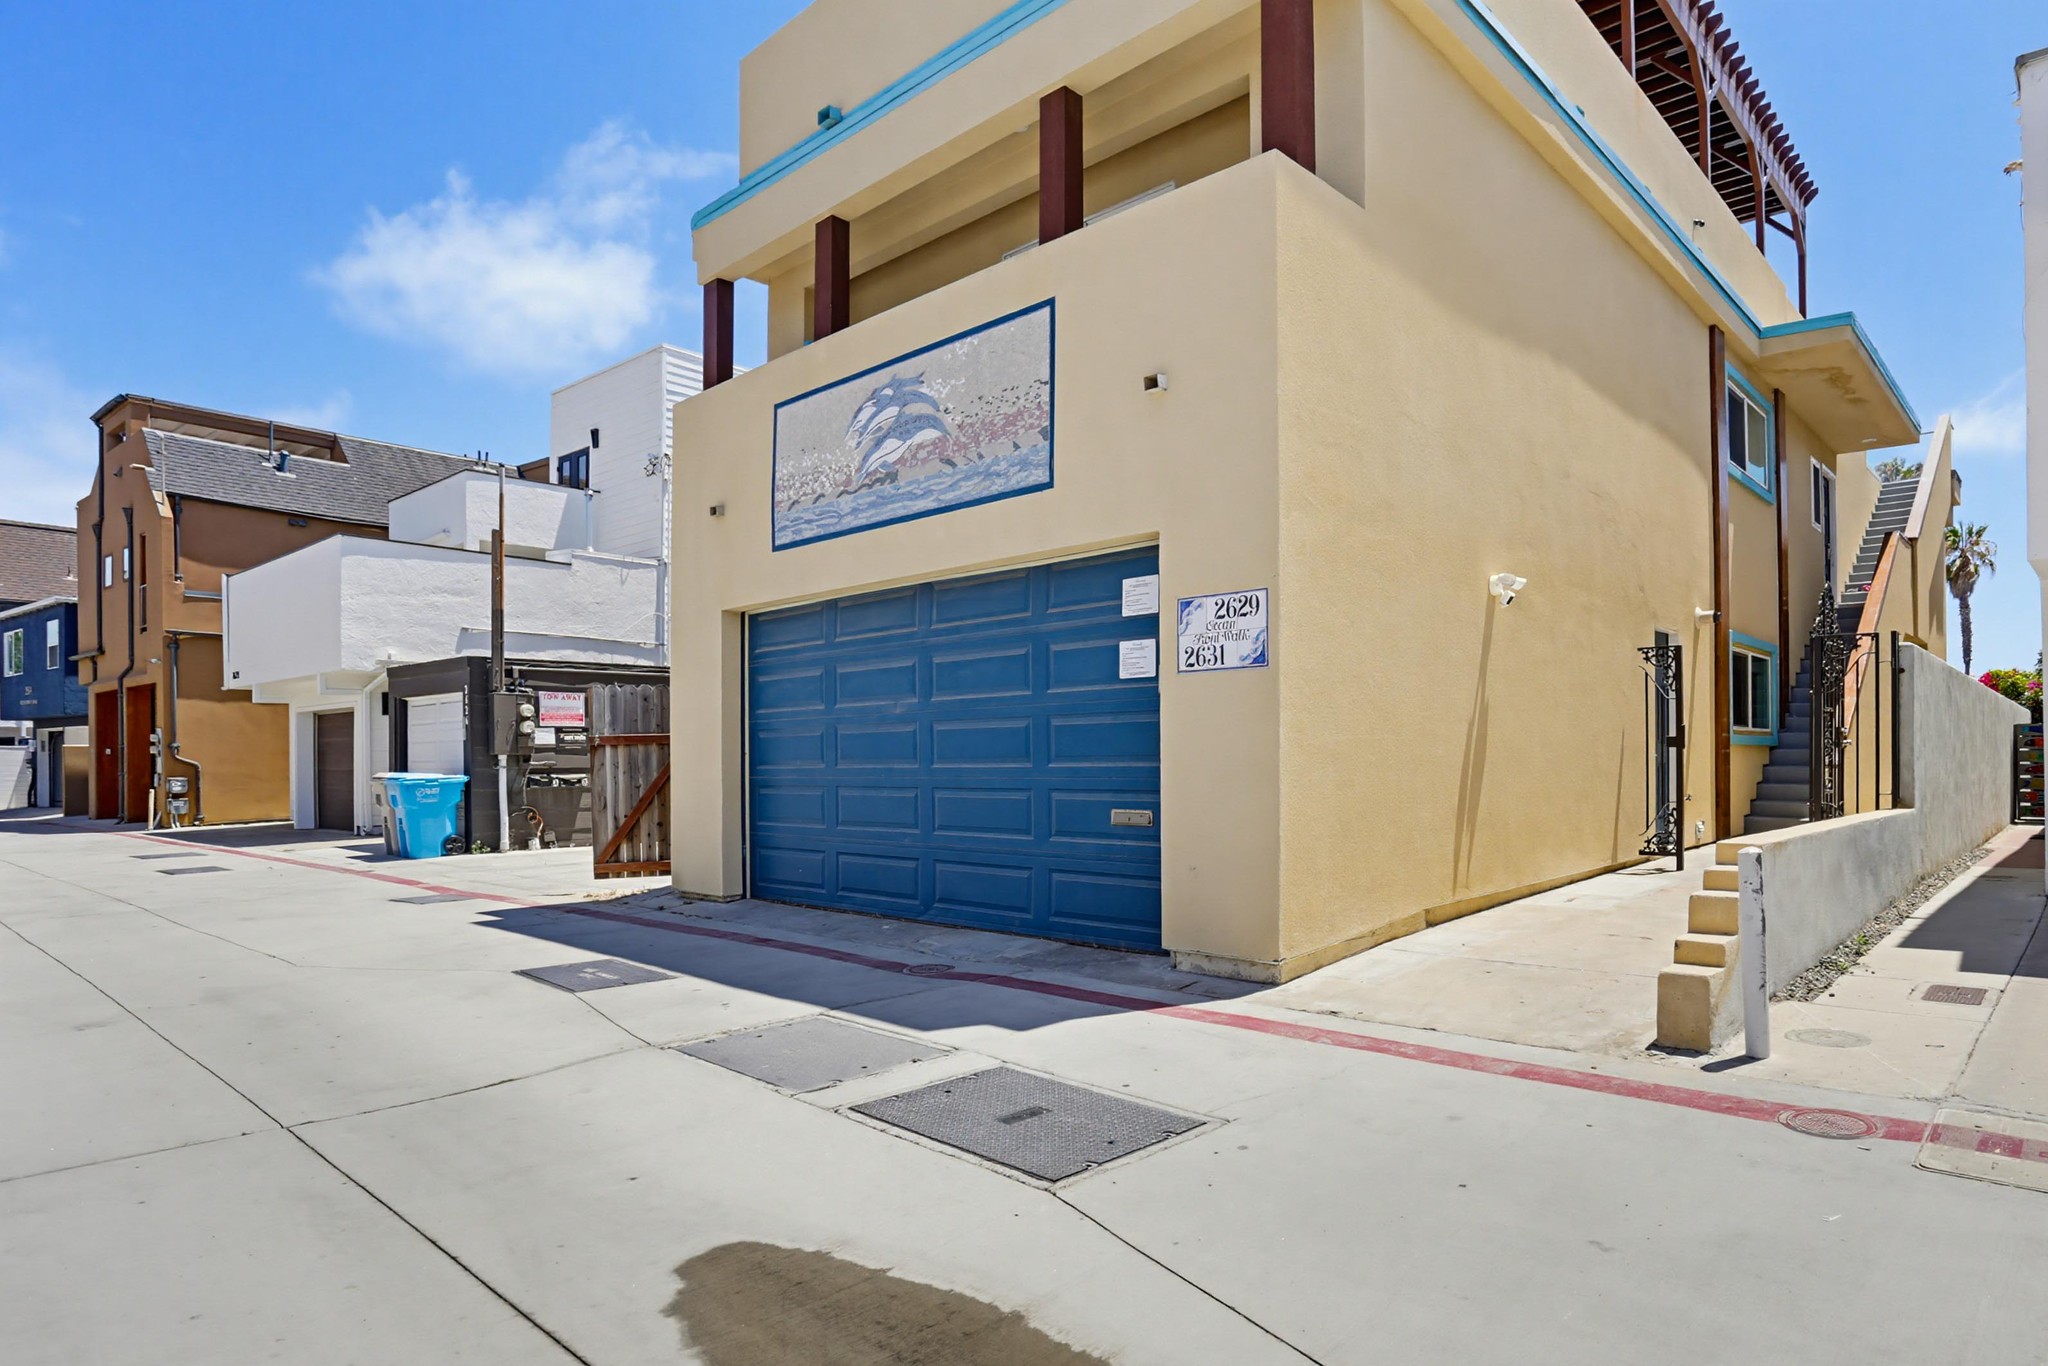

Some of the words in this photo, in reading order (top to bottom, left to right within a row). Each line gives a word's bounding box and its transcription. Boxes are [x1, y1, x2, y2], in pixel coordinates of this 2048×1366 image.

[1214, 593, 1260, 620] 2629
[1206, 620, 1236, 631] Ocean
[1193, 631, 1220, 645] Front
[1222, 629, 1250, 642] Walk
[1184, 644, 1225, 668] 2631
[560, 693, 582, 702] AWAY
